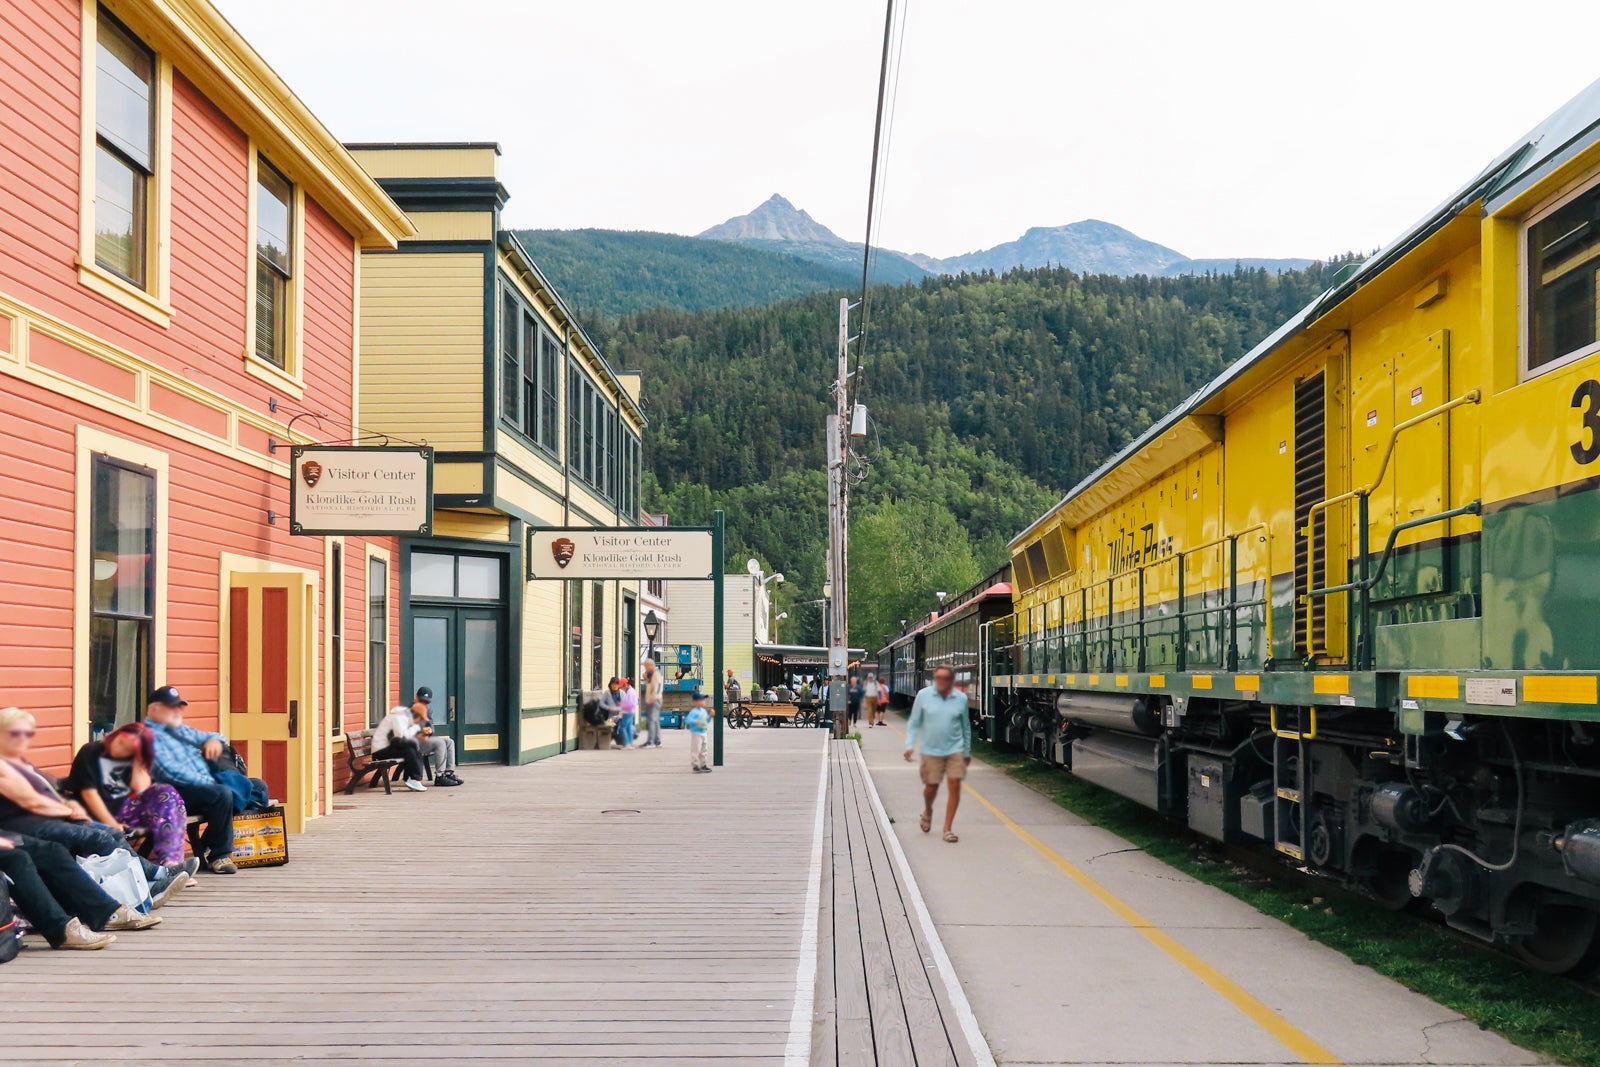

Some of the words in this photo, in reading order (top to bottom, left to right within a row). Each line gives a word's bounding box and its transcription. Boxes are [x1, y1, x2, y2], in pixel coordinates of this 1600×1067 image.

[1570, 379, 1600, 465] 3
[328, 468, 370, 480] Visitor
[373, 469, 416, 480] Center
[306, 494, 356, 504] Klondike
[358, 495, 384, 504] Gold
[389, 495, 416, 505] Rush
[593, 536, 631, 546] Visitor
[634, 536, 672, 546] Center
[583, 553, 627, 562] Klondike
[630, 553, 653, 562] Gold
[657, 553, 682, 562] Rush
